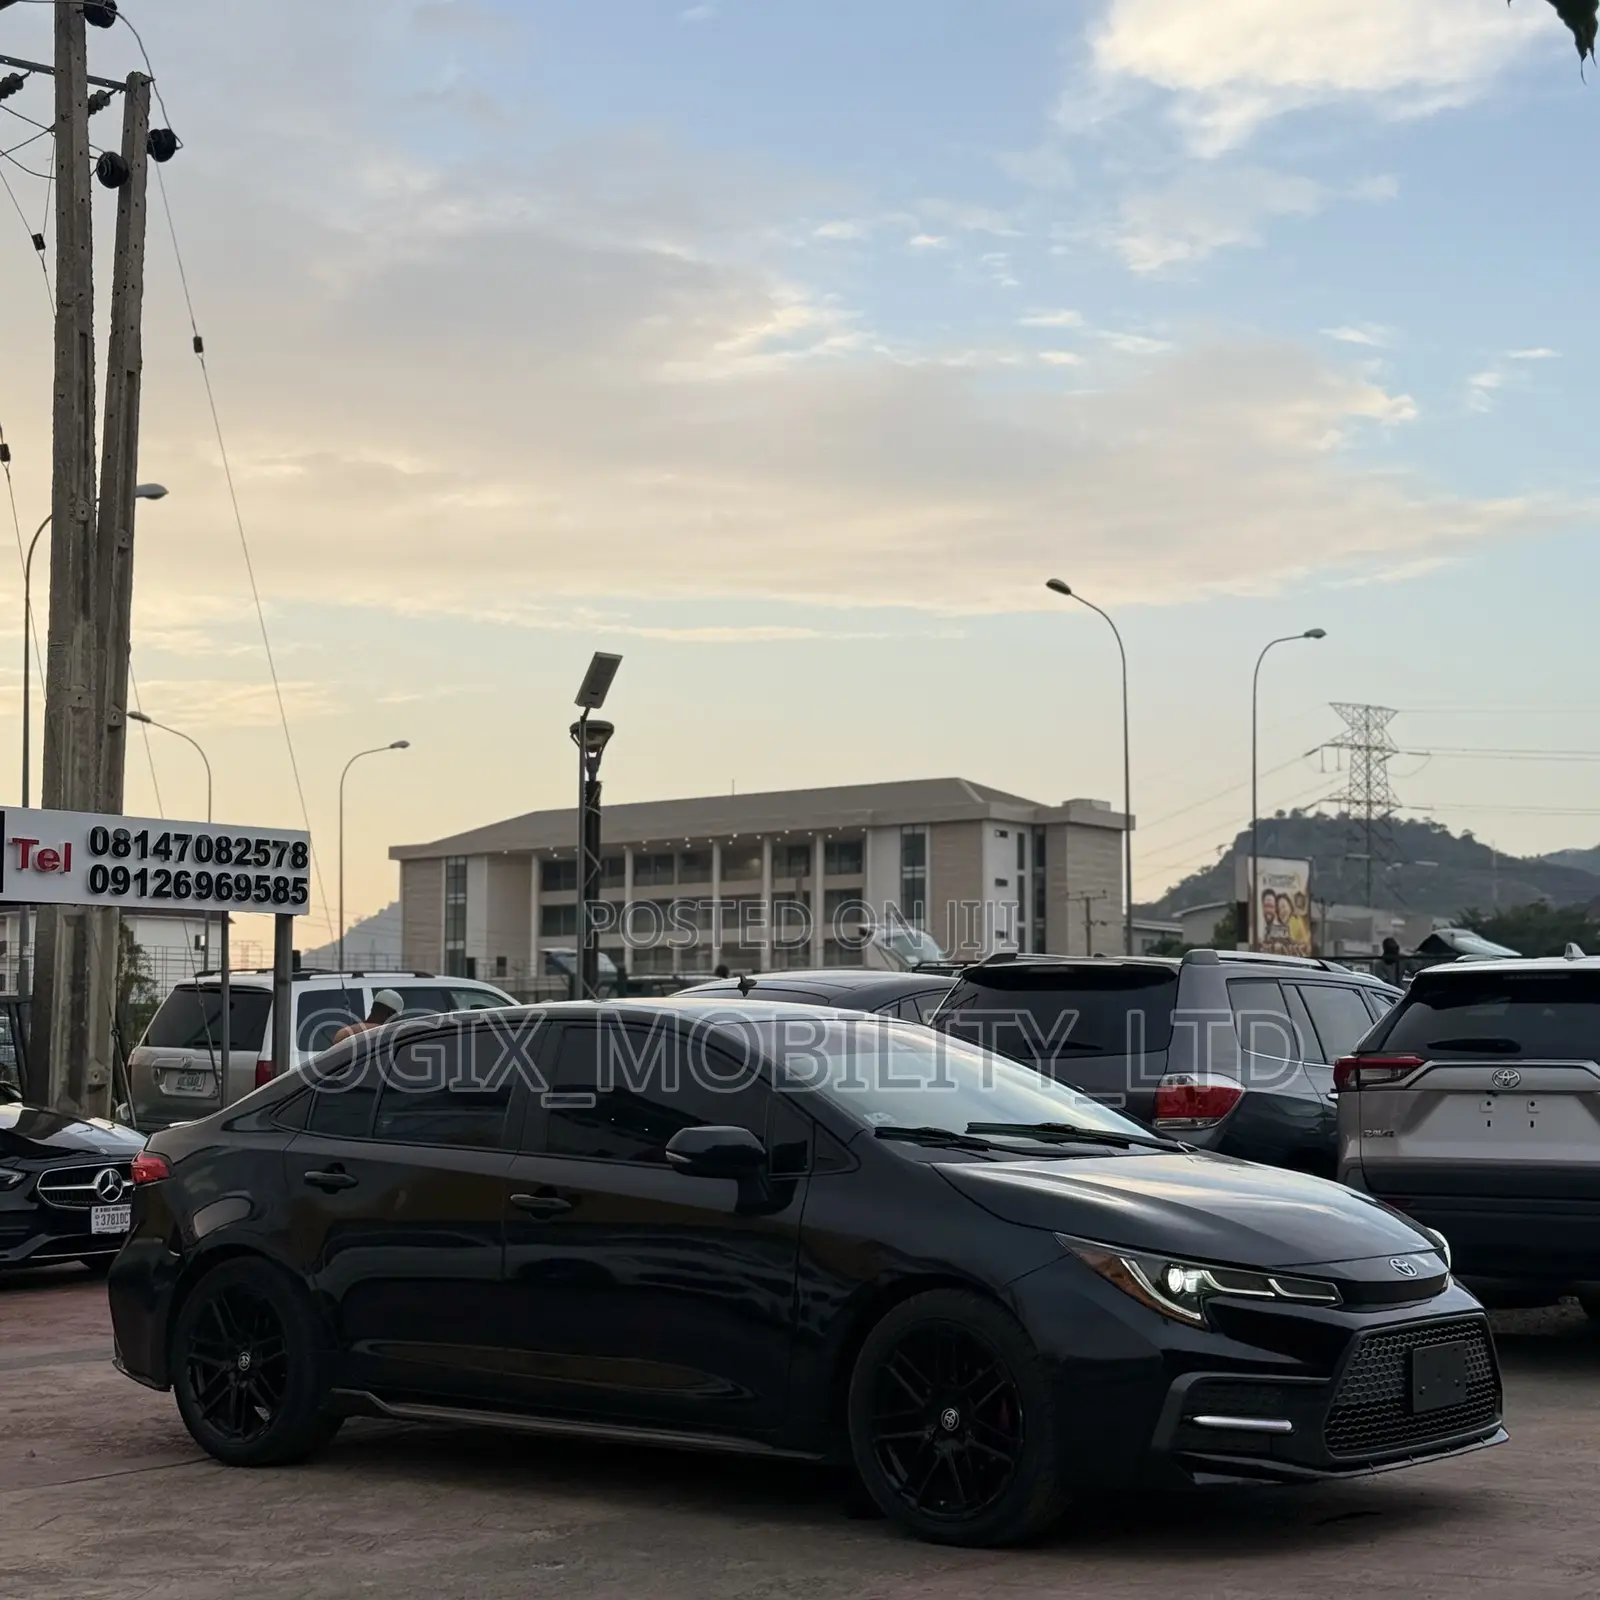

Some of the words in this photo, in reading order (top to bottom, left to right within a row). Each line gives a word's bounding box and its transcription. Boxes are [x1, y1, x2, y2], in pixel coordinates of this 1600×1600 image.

[9, 836, 72, 874] Tel
[87, 825, 309, 870] 08147082578
[87, 864, 309, 905] 09126969585
